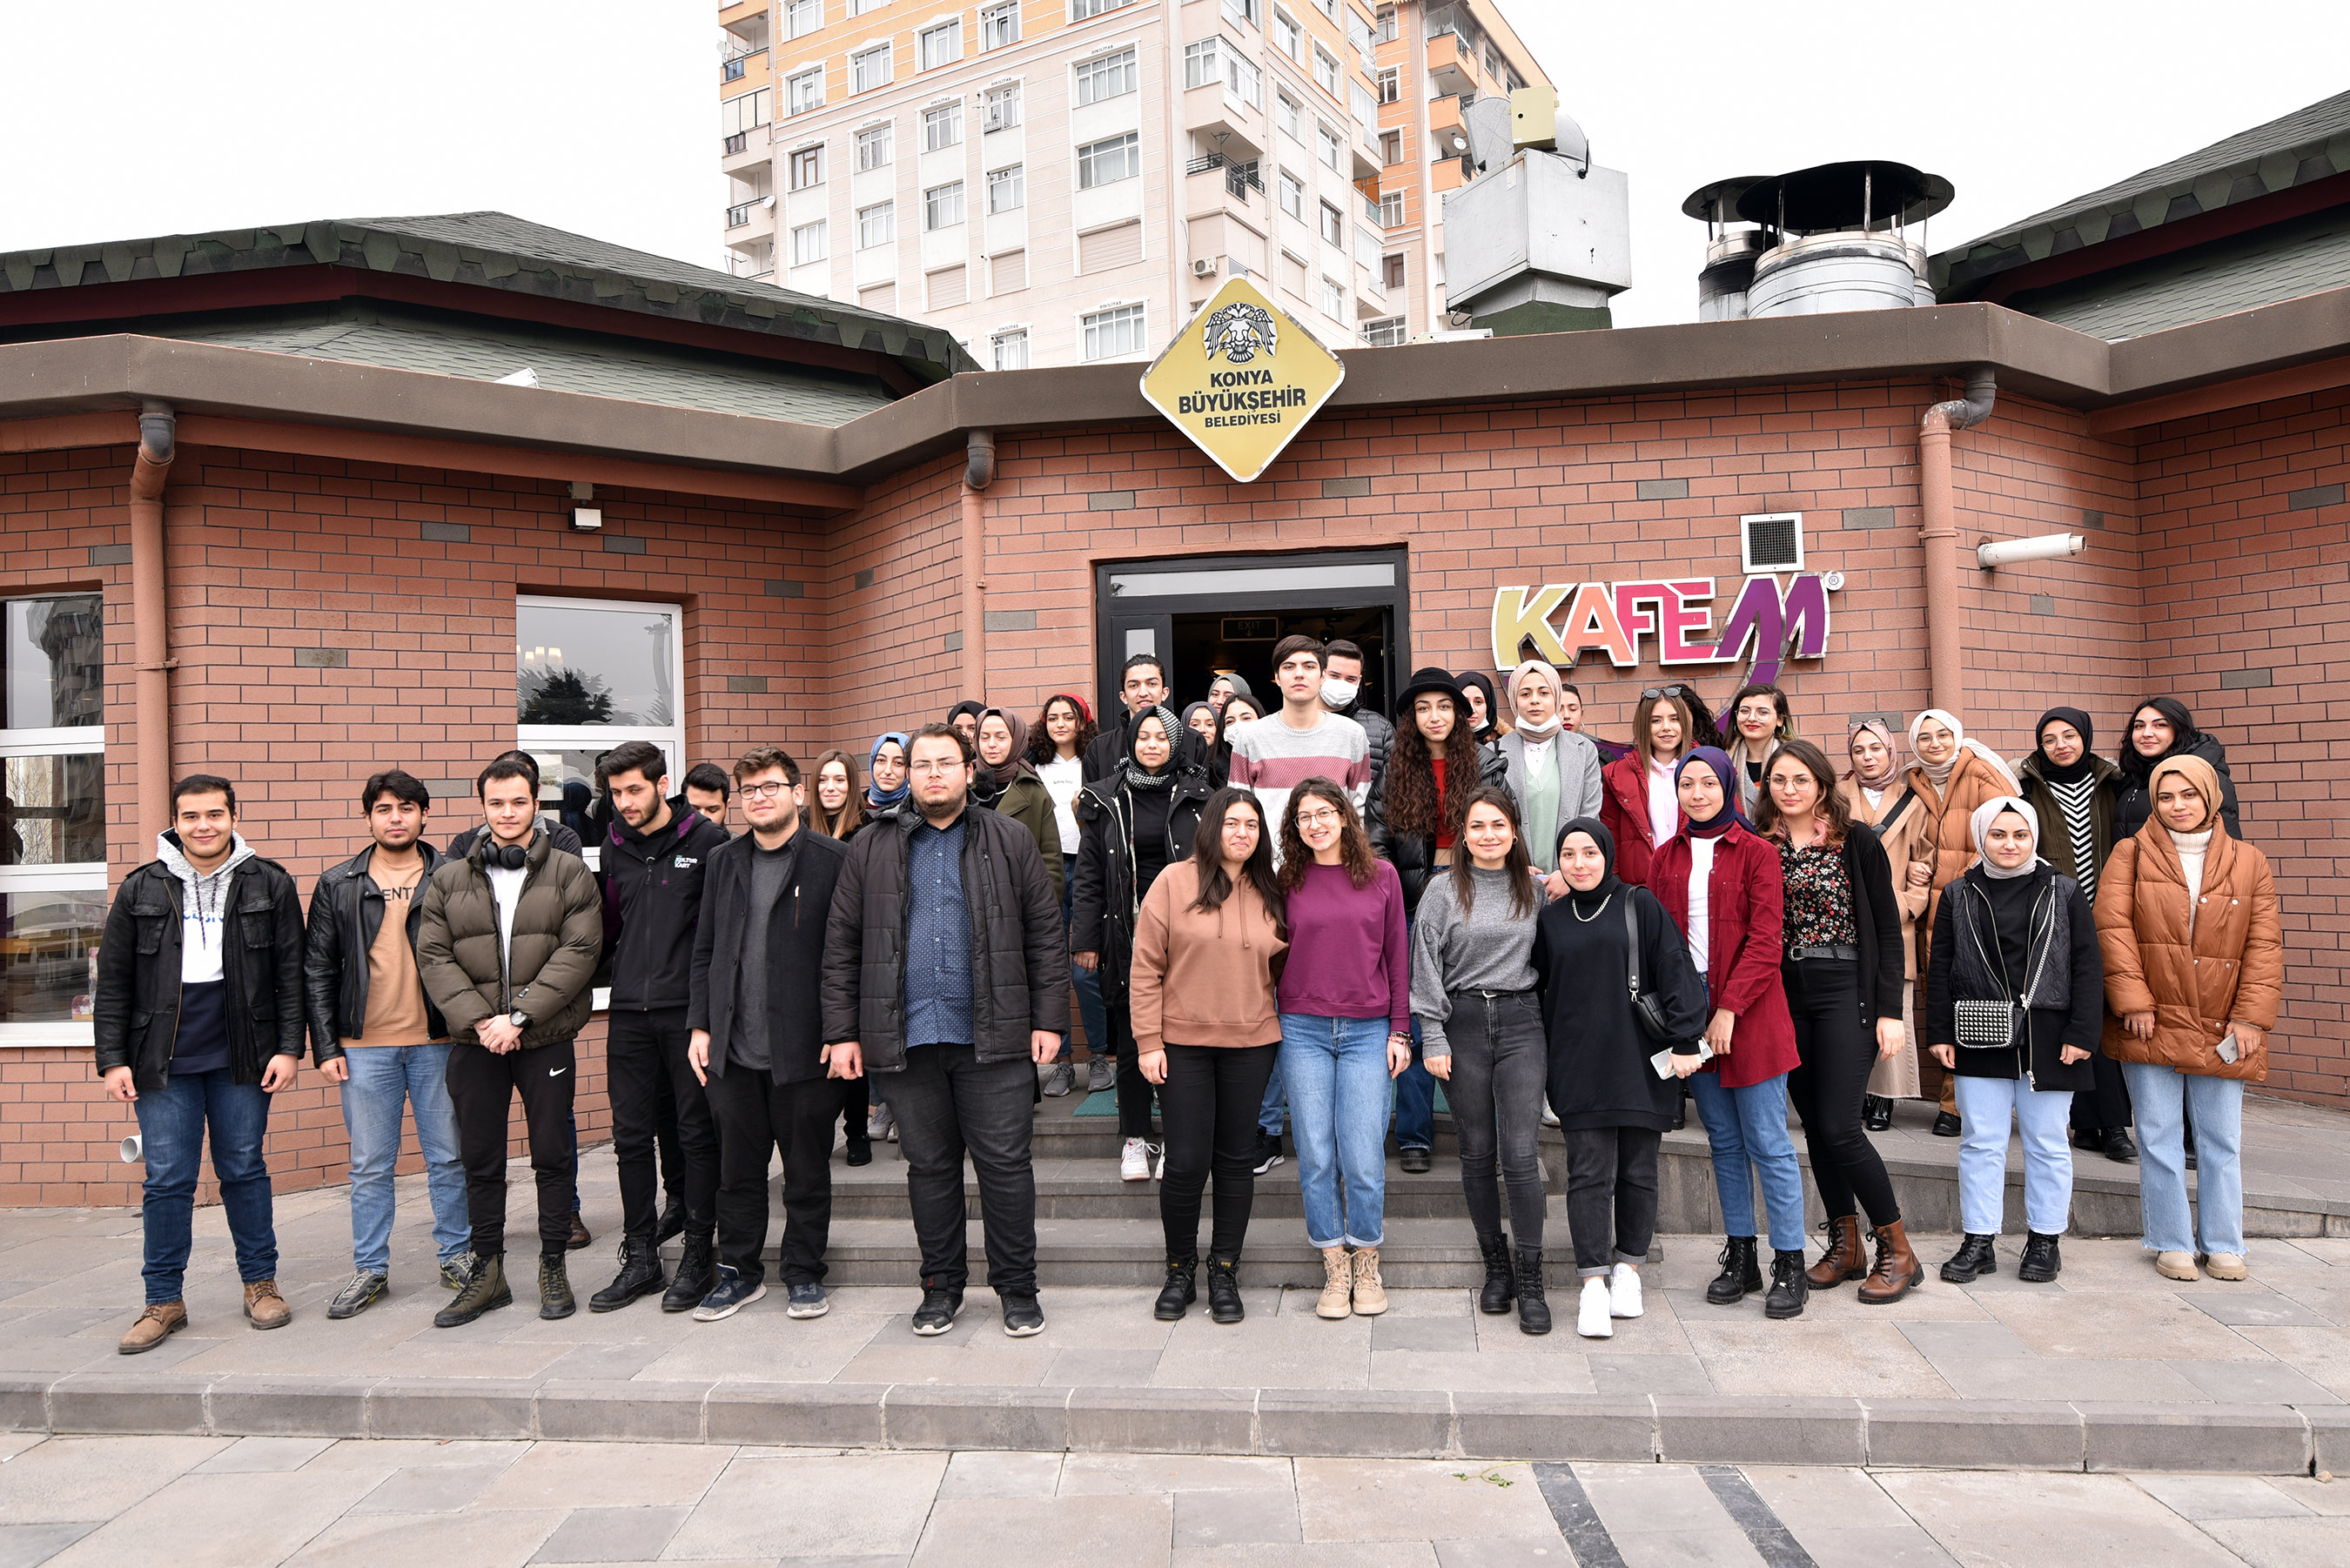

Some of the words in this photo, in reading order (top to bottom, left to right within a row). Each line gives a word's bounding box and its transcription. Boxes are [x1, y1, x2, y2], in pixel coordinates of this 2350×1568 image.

[1210, 369, 1273, 388] KONYA
[1178, 384, 1306, 414] BÜYÜKŞEHİR
[1205, 412, 1281, 428] BELEDİYESİ
[1238, 620, 1261, 631] EXIT
[1491, 572, 1830, 676] KAFEM
[381, 886, 418, 901] ENT
